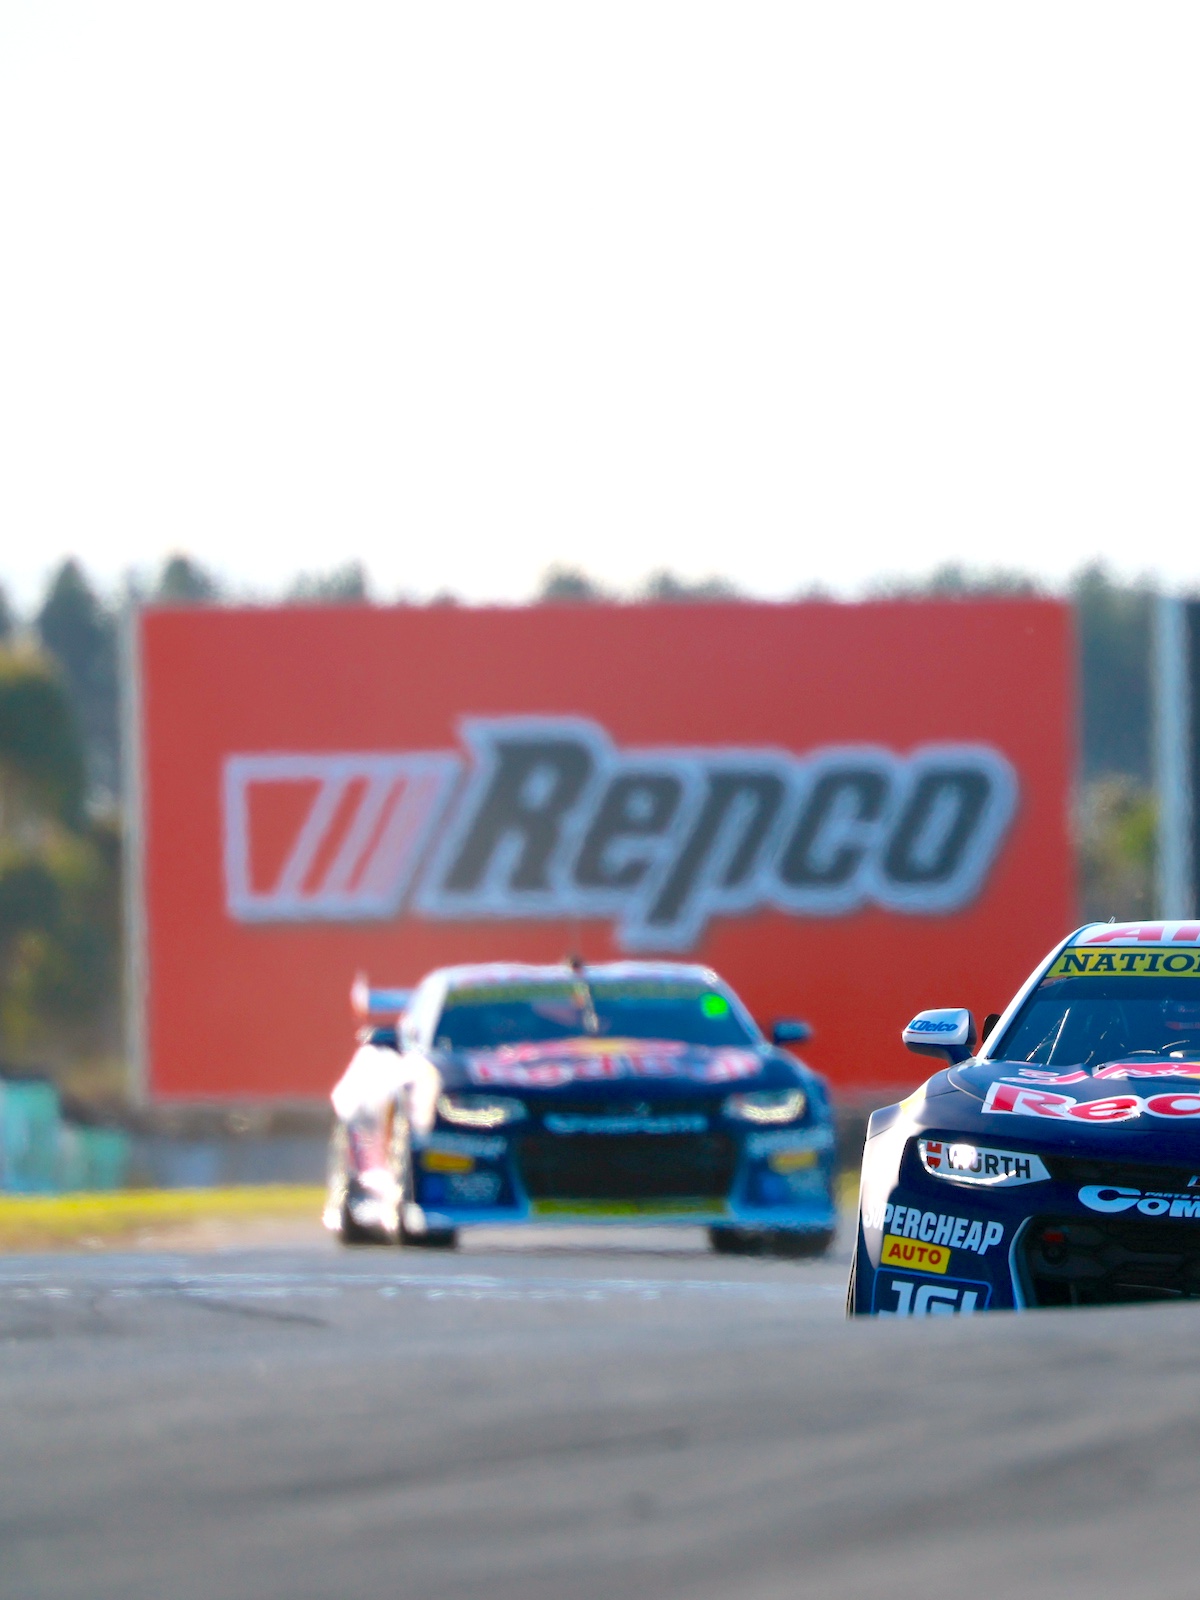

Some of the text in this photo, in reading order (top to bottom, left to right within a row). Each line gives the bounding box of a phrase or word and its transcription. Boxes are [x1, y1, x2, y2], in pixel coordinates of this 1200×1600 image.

[424, 720, 1008, 944] Repco
[946, 1148, 1031, 1179] ÜRTH
[888, 1243, 942, 1265] AUTO
